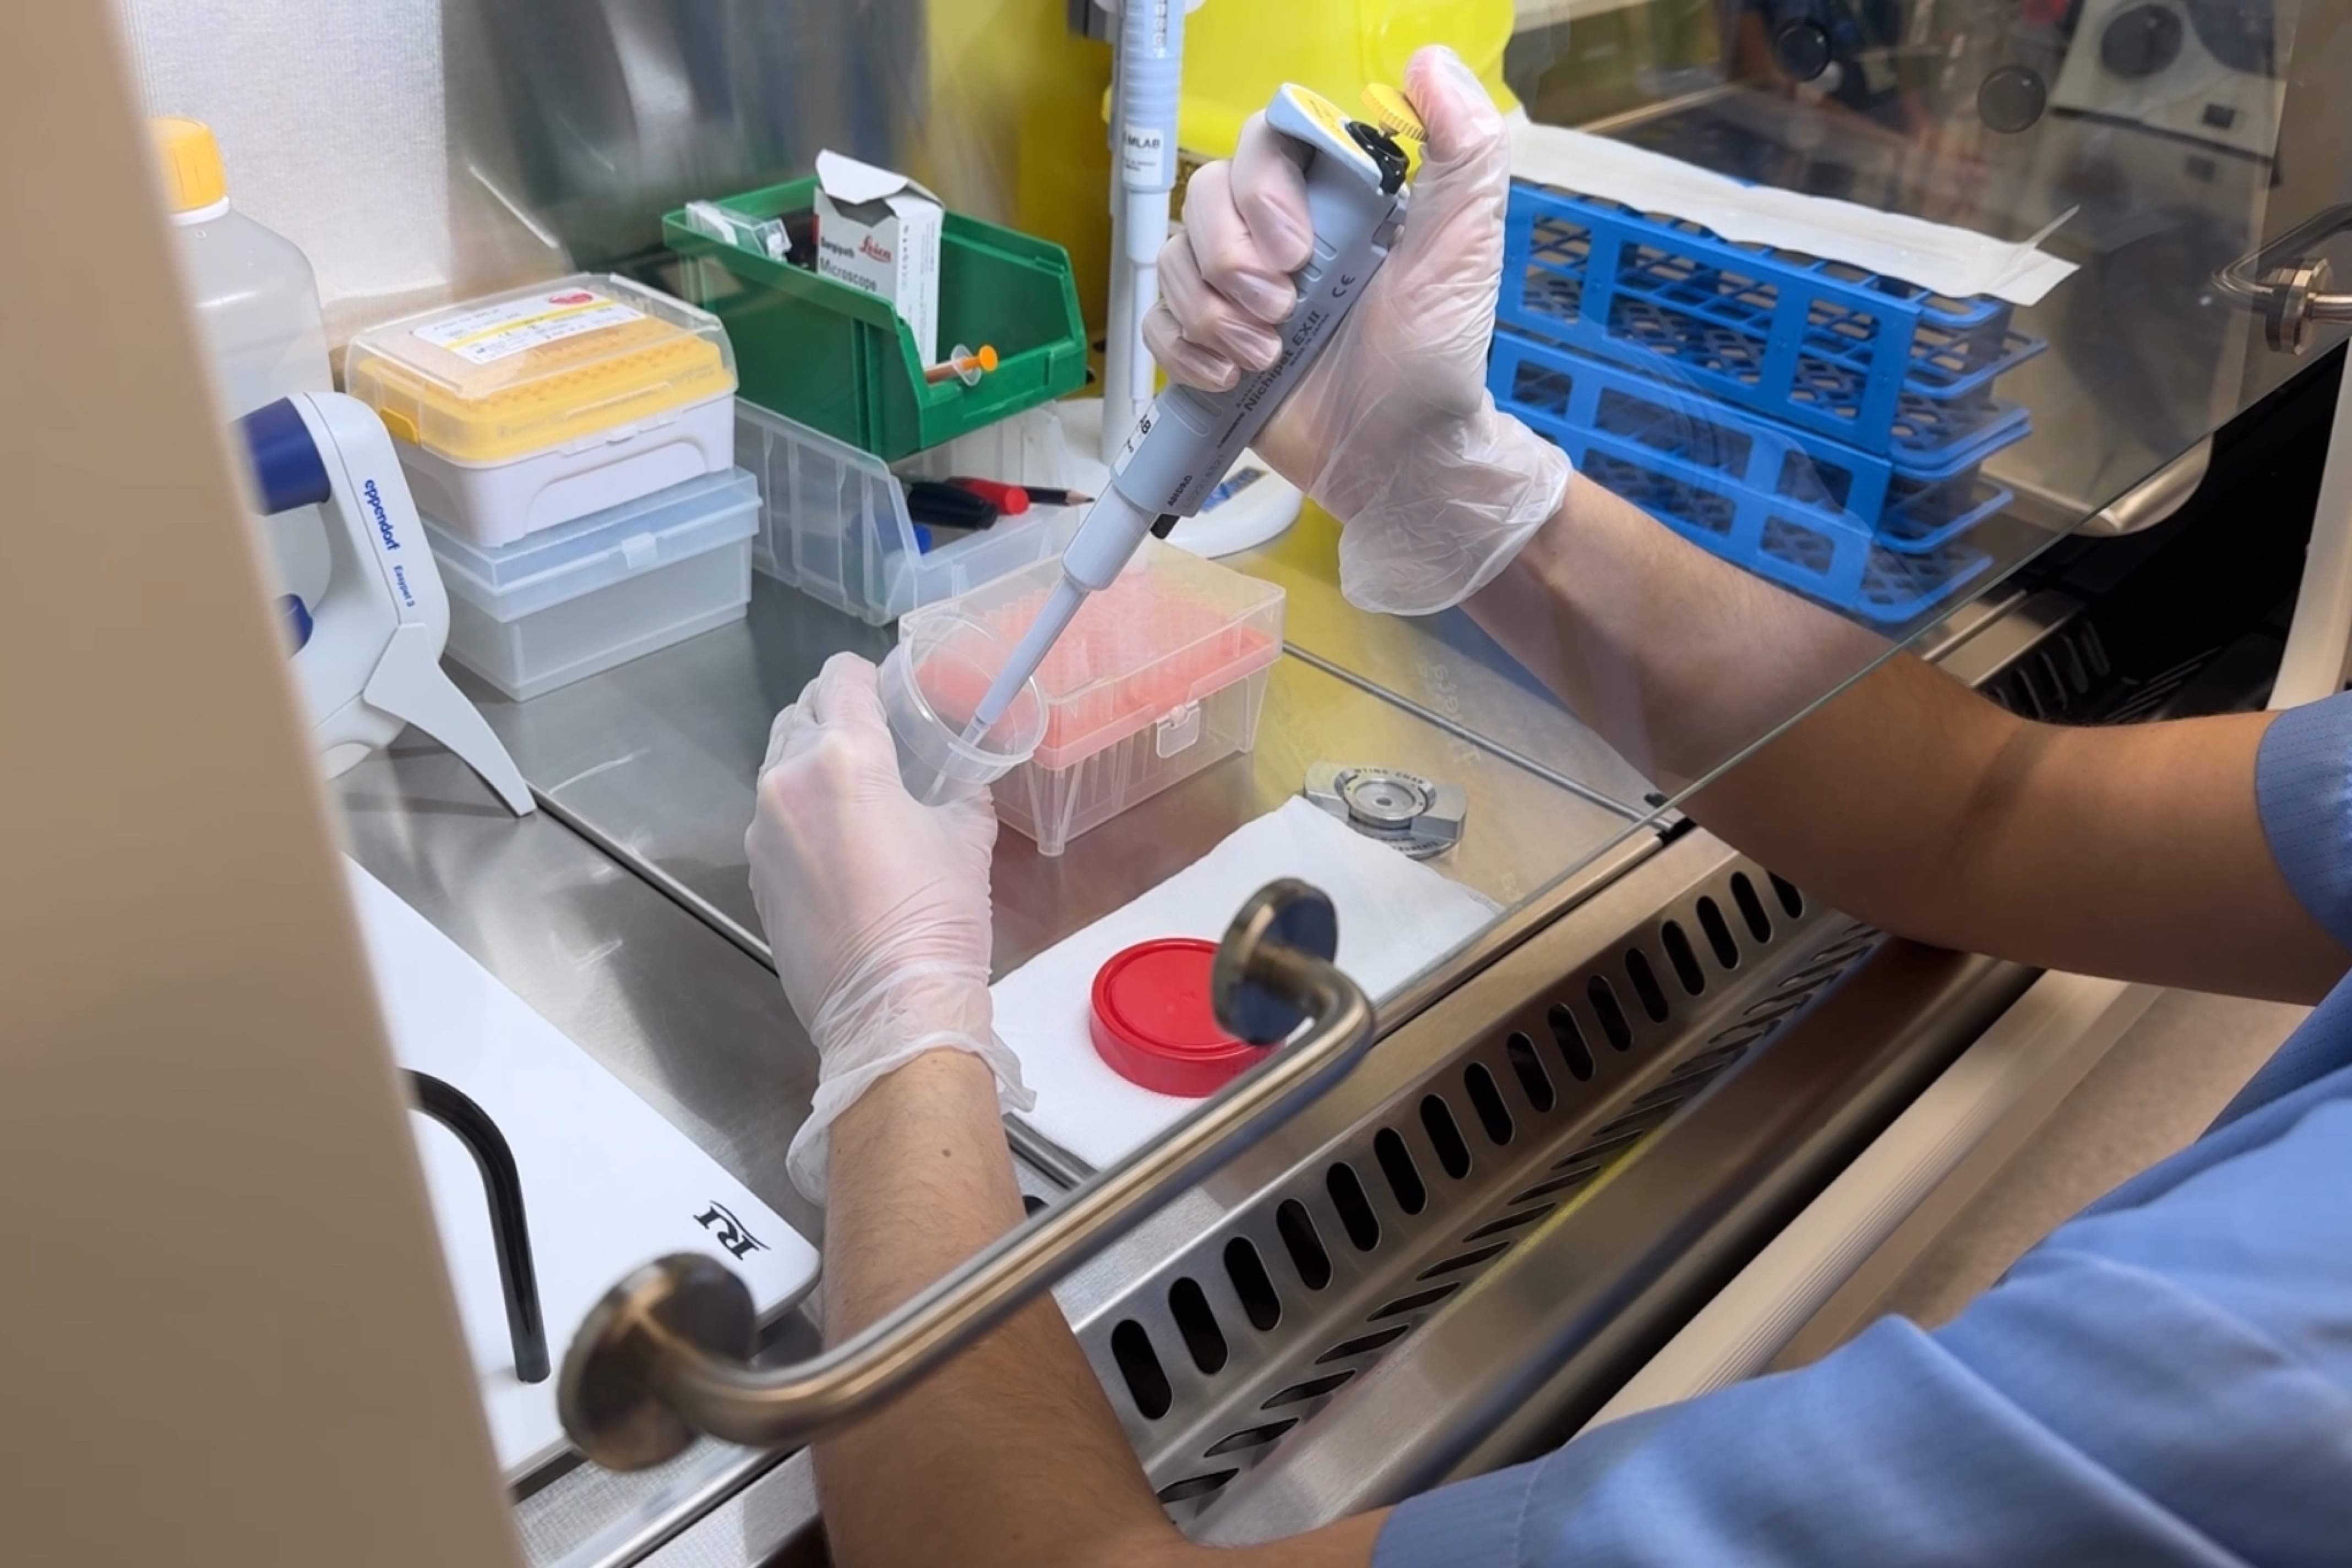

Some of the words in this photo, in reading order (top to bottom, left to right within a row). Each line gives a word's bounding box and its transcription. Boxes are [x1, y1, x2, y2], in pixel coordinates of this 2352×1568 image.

[819, 258, 878, 291] Microscope
[1244, 349, 1295, 412] Nichipet
[364, 480, 401, 551] eppendorf
[394, 565, 412, 599] Easypet
